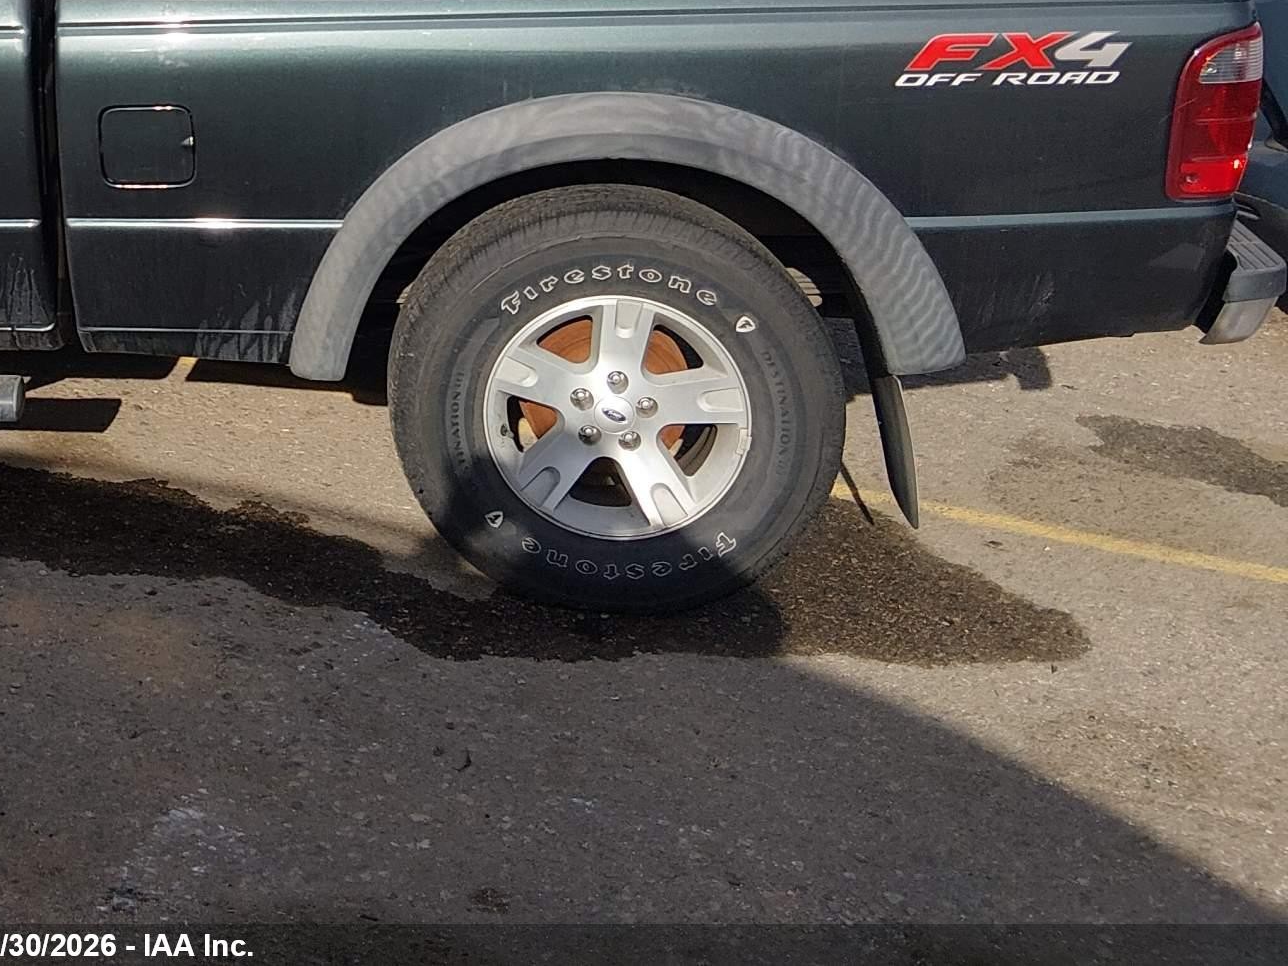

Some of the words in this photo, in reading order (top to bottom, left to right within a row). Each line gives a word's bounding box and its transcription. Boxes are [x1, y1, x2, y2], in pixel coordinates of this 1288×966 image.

[904, 31, 1132, 71] FX4
[895, 72, 982, 87] OFF
[992, 71, 1120, 85] ROAD
[500, 262, 718, 315] Firestone
[521, 532, 738, 581] Firestone
